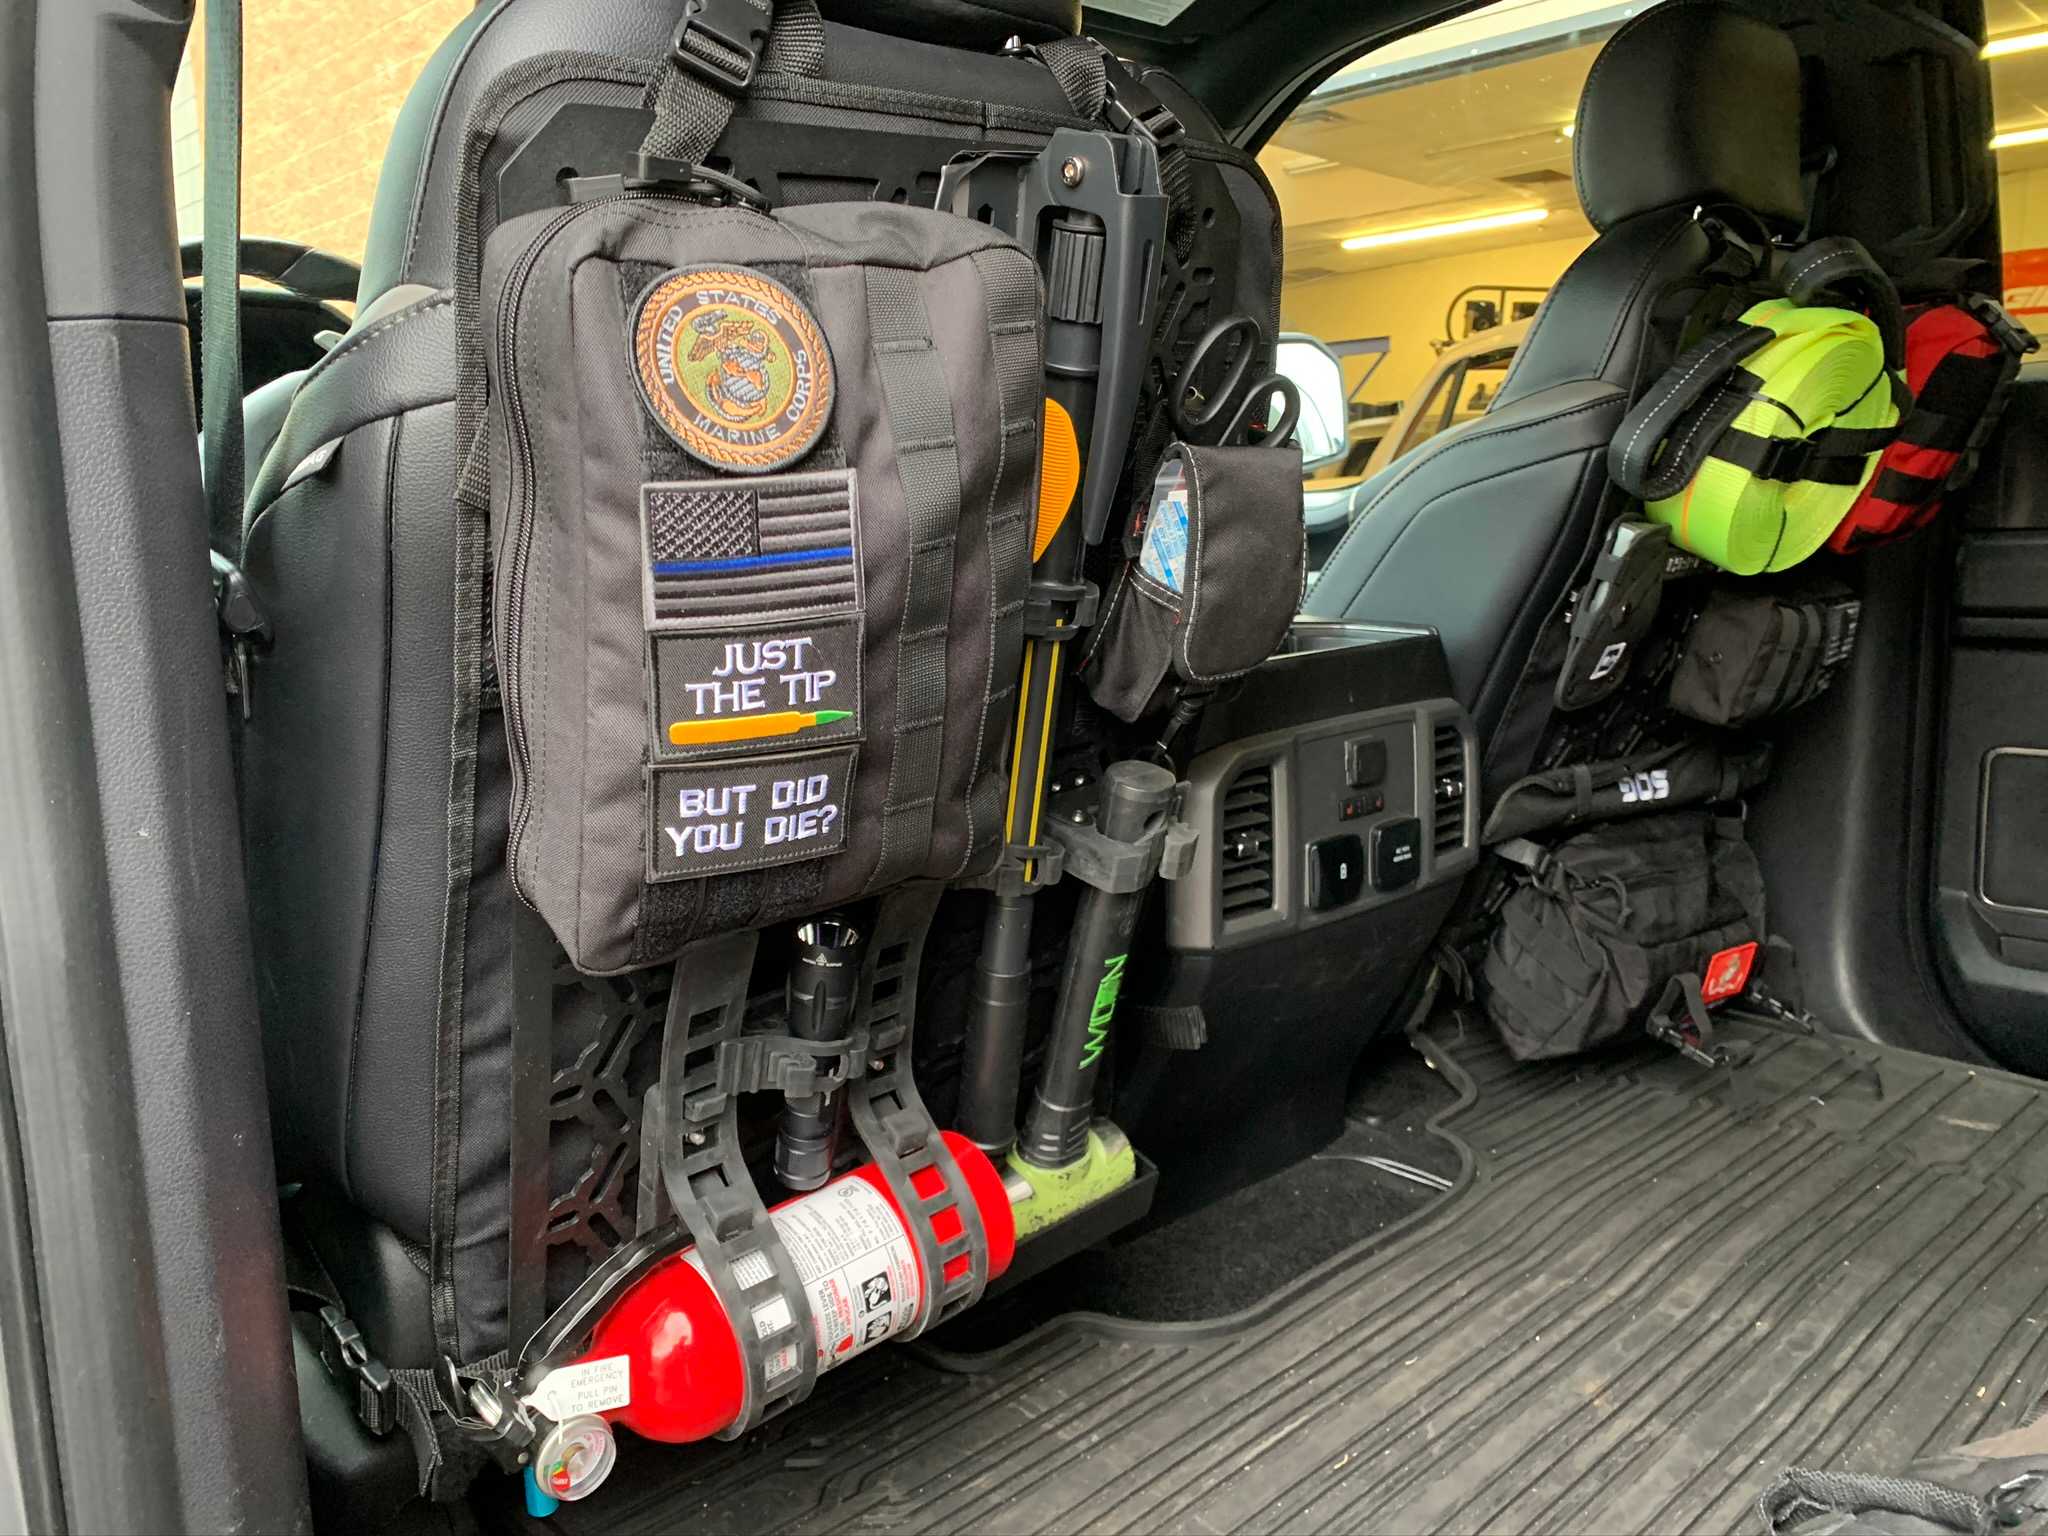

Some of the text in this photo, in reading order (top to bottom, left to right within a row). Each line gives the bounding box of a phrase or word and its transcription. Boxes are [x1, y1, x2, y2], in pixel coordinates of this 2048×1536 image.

[656, 289, 782, 384] UNITED STATES
[693, 350, 812, 446] MARINE CORPS
[711, 636, 813, 677] JUST
[685, 669, 837, 715] THE TIP
[679, 774, 829, 818] BUT DID
[665, 804, 838, 857] YOU DIE?
[570, 1369, 624, 1389] EMERGENCY
[587, 1393, 625, 1409] REMOVE
